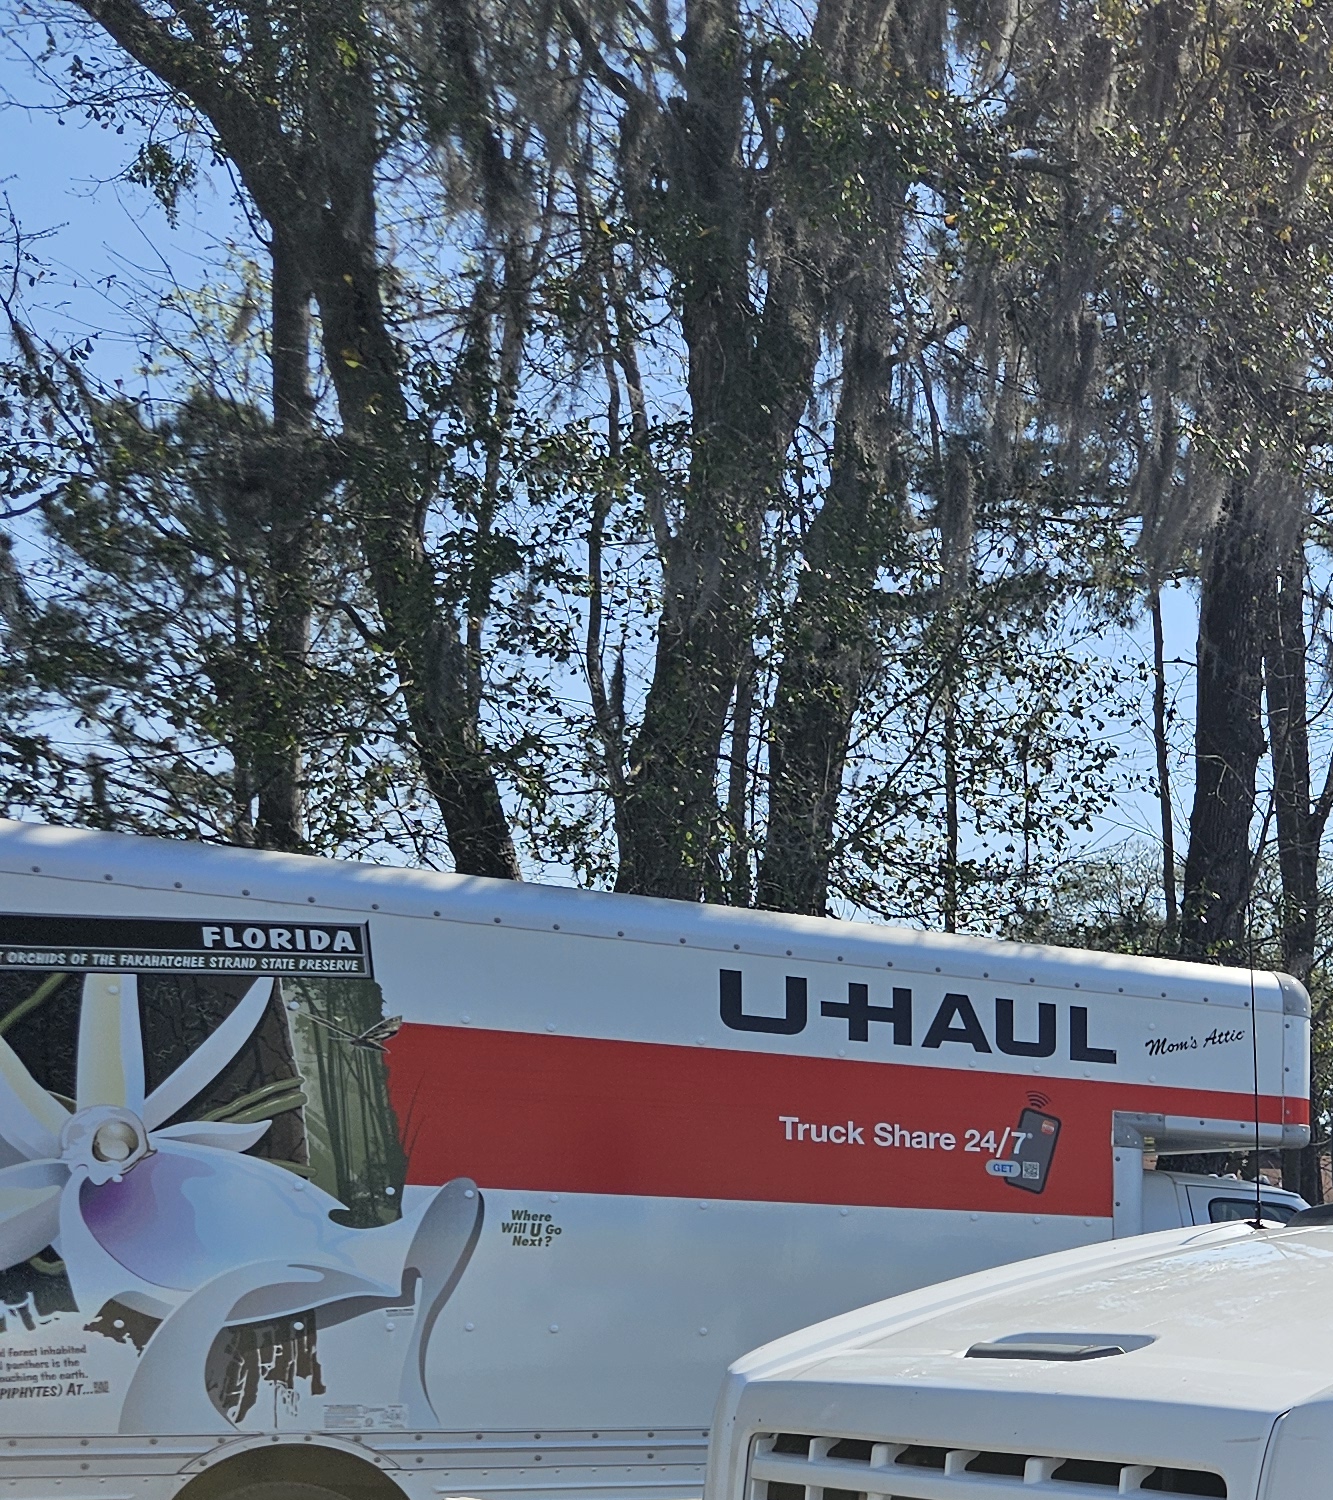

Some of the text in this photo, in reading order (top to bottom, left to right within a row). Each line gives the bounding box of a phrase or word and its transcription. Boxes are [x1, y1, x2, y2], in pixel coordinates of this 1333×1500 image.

[202, 926, 356, 951] FLORIDA
[6, 951, 66, 965] ORCHIDS
[71, 953, 88, 965] OF
[92, 953, 116, 966] THE
[120, 953, 205, 968] FAKAHATCHEE
[209, 955, 257, 969] STRAND
[261, 957, 296, 970] STATE
[299, 958, 359, 972] PRESERVE
[719, 969, 1116, 1065] U-HAUL
[1144, 1028, 1245, 1056] Mom's Attic
[778, 1115, 865, 1146] Truck
[873, 1122, 957, 1151] Share
[993, 1163, 1014, 1174] GET
[511, 1209, 552, 1222] Where
[501, 1222, 562, 1237] Will U Go
[8, 1347, 38, 1357] forest
[40, 1344, 87, 1356] inhabited
[6, 1357, 81, 1372] panthers is the
[41, 1371, 57, 1381] the
[59, 1369, 89, 1380] earth.
